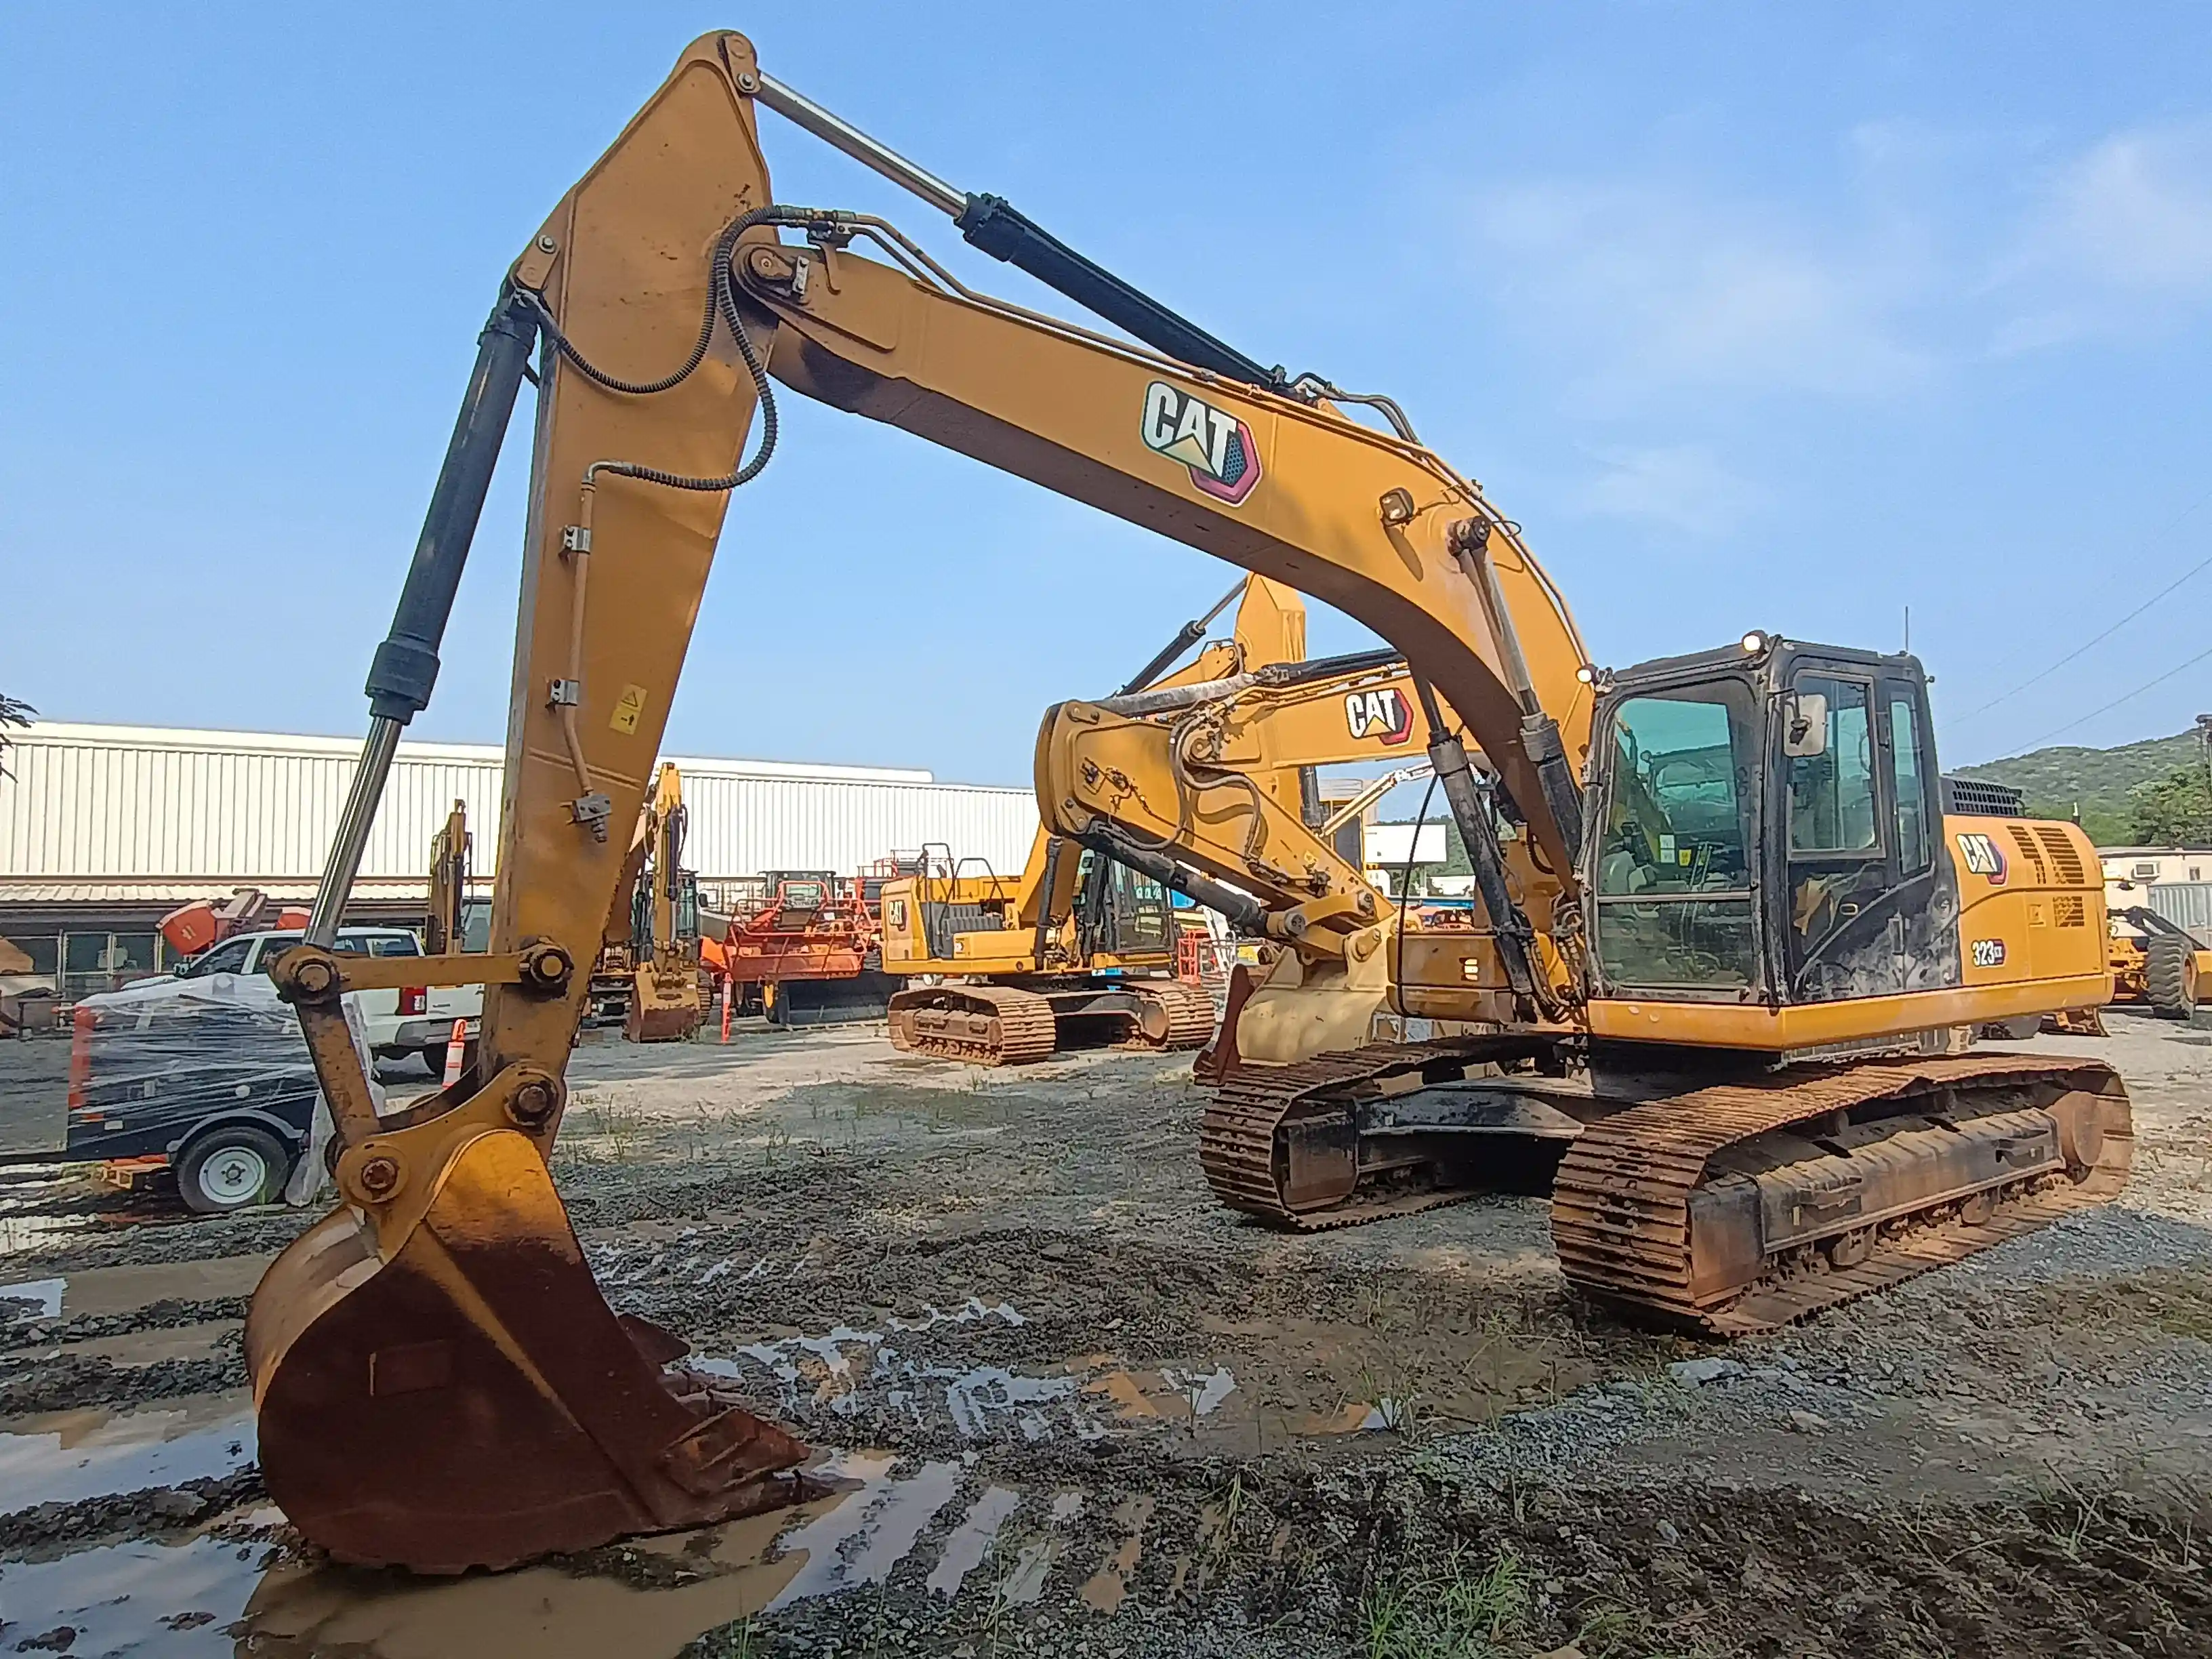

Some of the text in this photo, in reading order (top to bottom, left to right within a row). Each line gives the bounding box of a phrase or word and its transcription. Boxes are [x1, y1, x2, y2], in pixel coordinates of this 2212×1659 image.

[1143, 383, 1237, 478] CAT
[1346, 689, 1396, 737] CAT
[1957, 834, 1998, 873] CAT
[1972, 941, 1994, 966] 323
